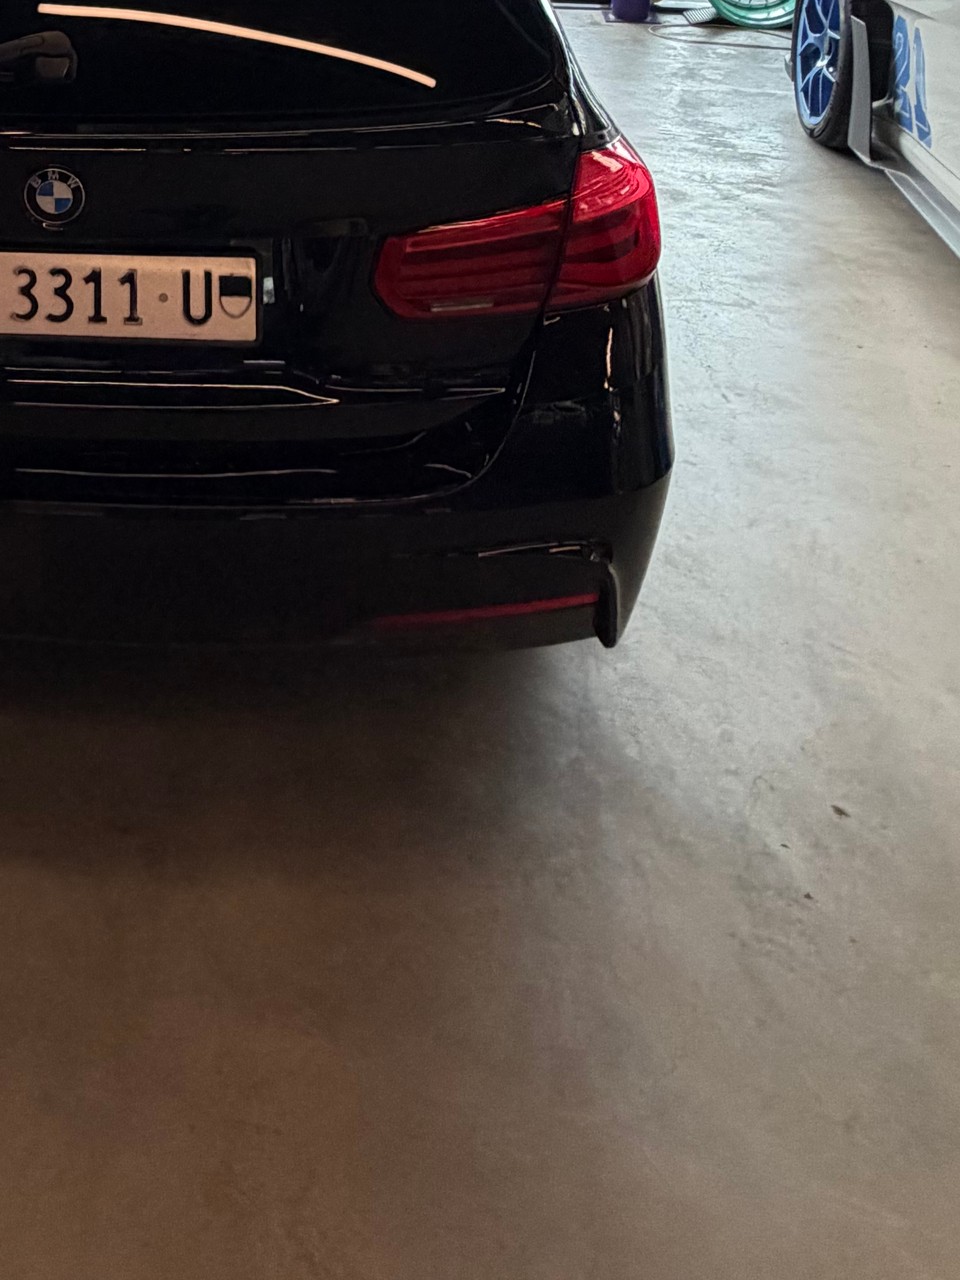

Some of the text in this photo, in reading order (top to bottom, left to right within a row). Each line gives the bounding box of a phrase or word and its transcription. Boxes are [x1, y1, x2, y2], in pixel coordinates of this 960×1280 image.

[30, 170, 80, 189] BMW
[10, 267, 143, 326] 3311
[182, 270, 212, 325] U
